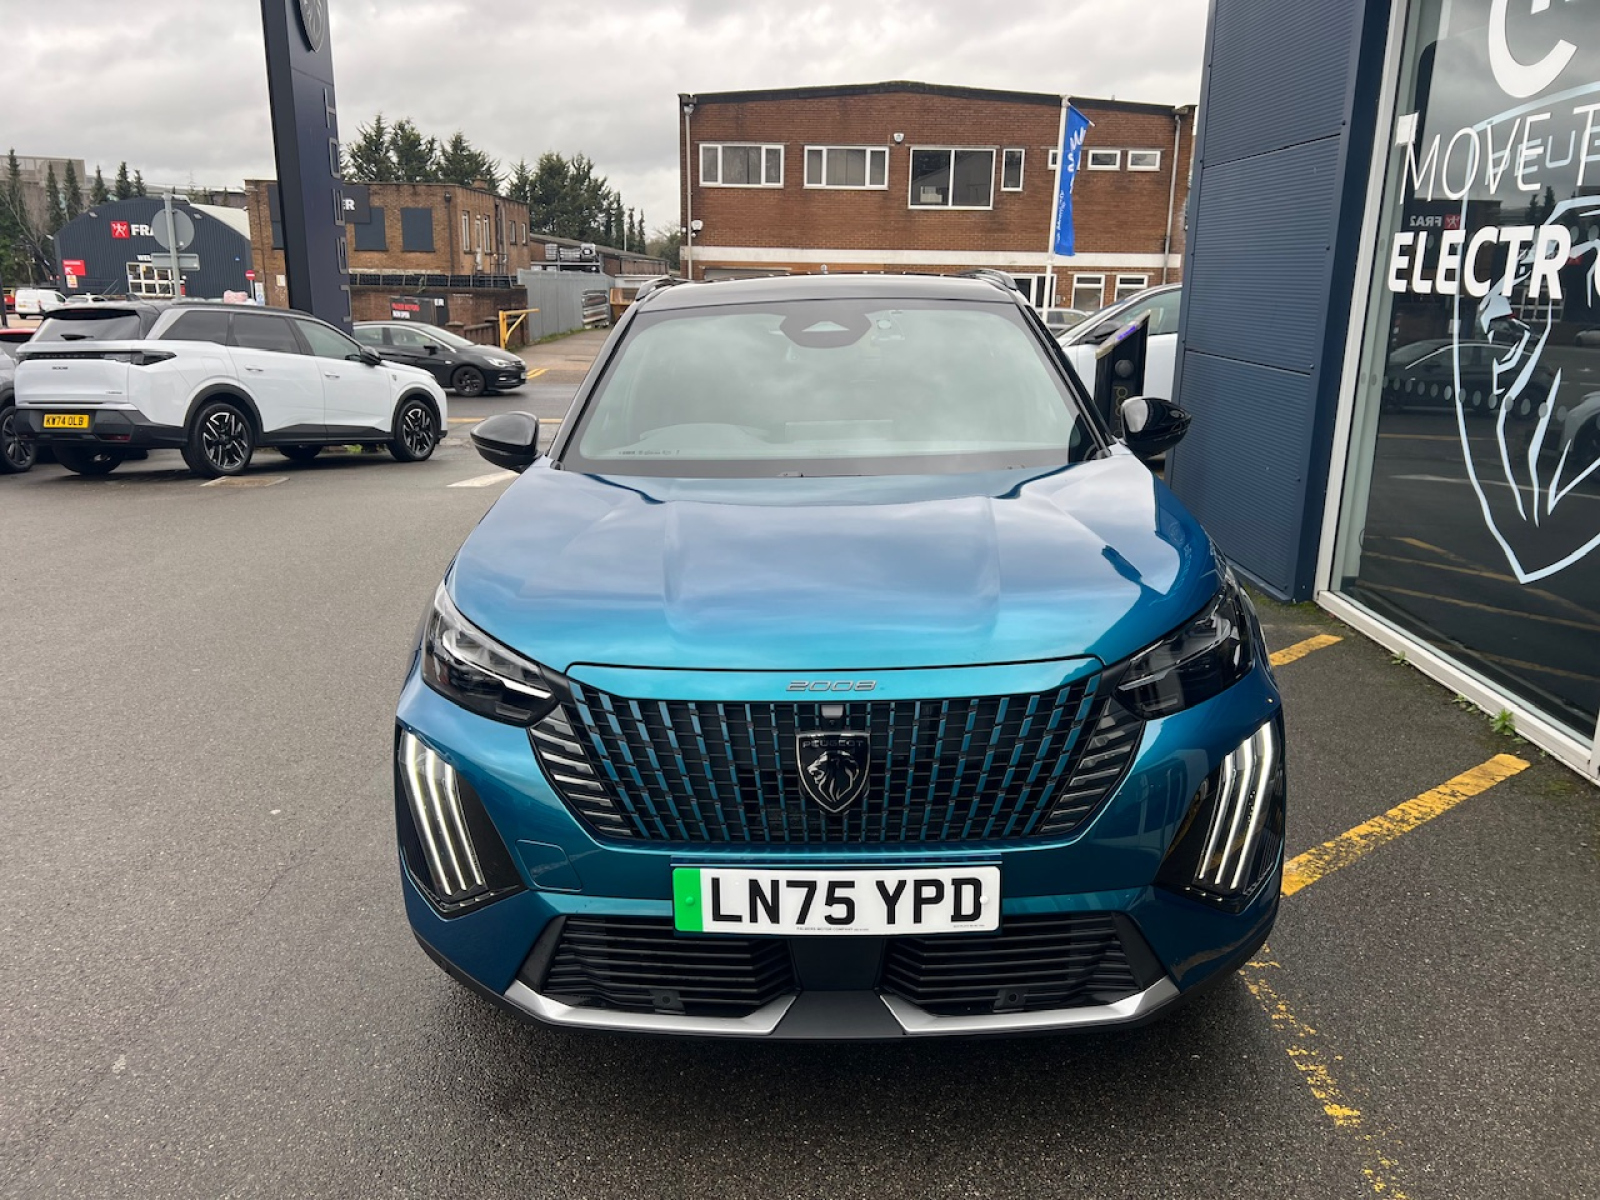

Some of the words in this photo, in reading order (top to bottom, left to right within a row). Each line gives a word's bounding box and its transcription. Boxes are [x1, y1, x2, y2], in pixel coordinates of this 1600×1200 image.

[1399, 112, 1551, 204] MOVE
[786, 680, 877, 692] 2008
[802, 739, 864, 748] PEUGEOT
[711, 877, 856, 925] LN75
[875, 877, 982, 925] YPD
